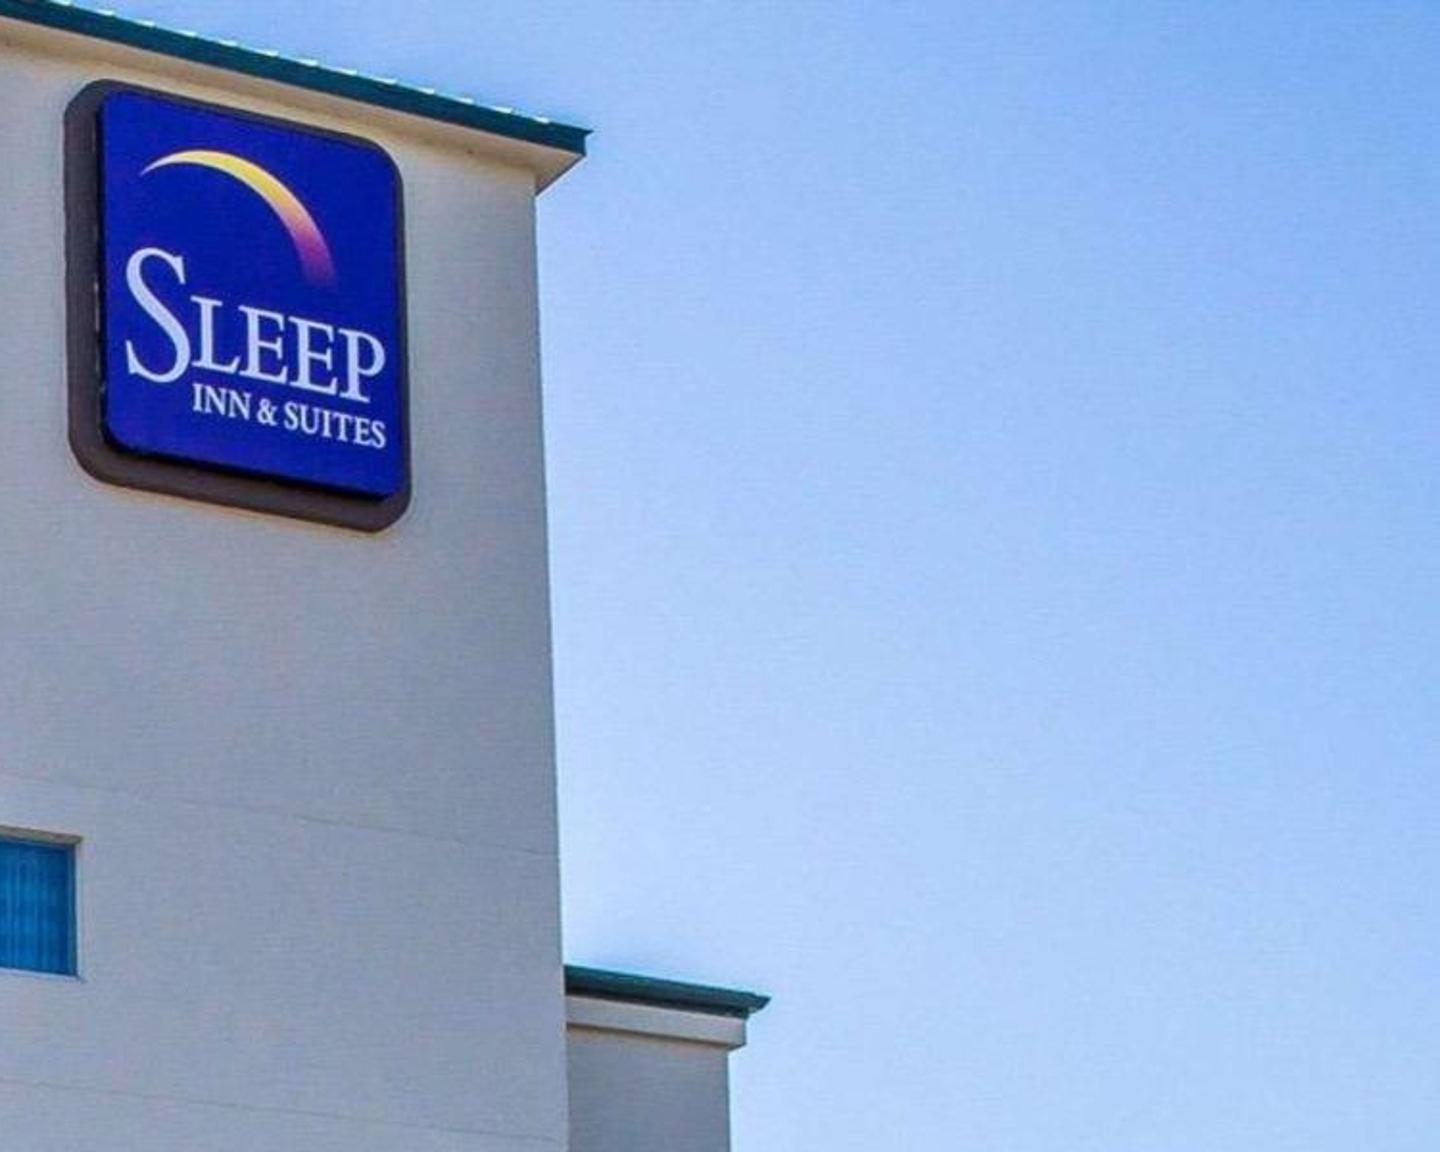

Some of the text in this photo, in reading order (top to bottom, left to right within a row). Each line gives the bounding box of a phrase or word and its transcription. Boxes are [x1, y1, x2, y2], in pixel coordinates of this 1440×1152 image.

[126, 248, 386, 402] SLEEP
[192, 383, 386, 449] INN & SUITES
